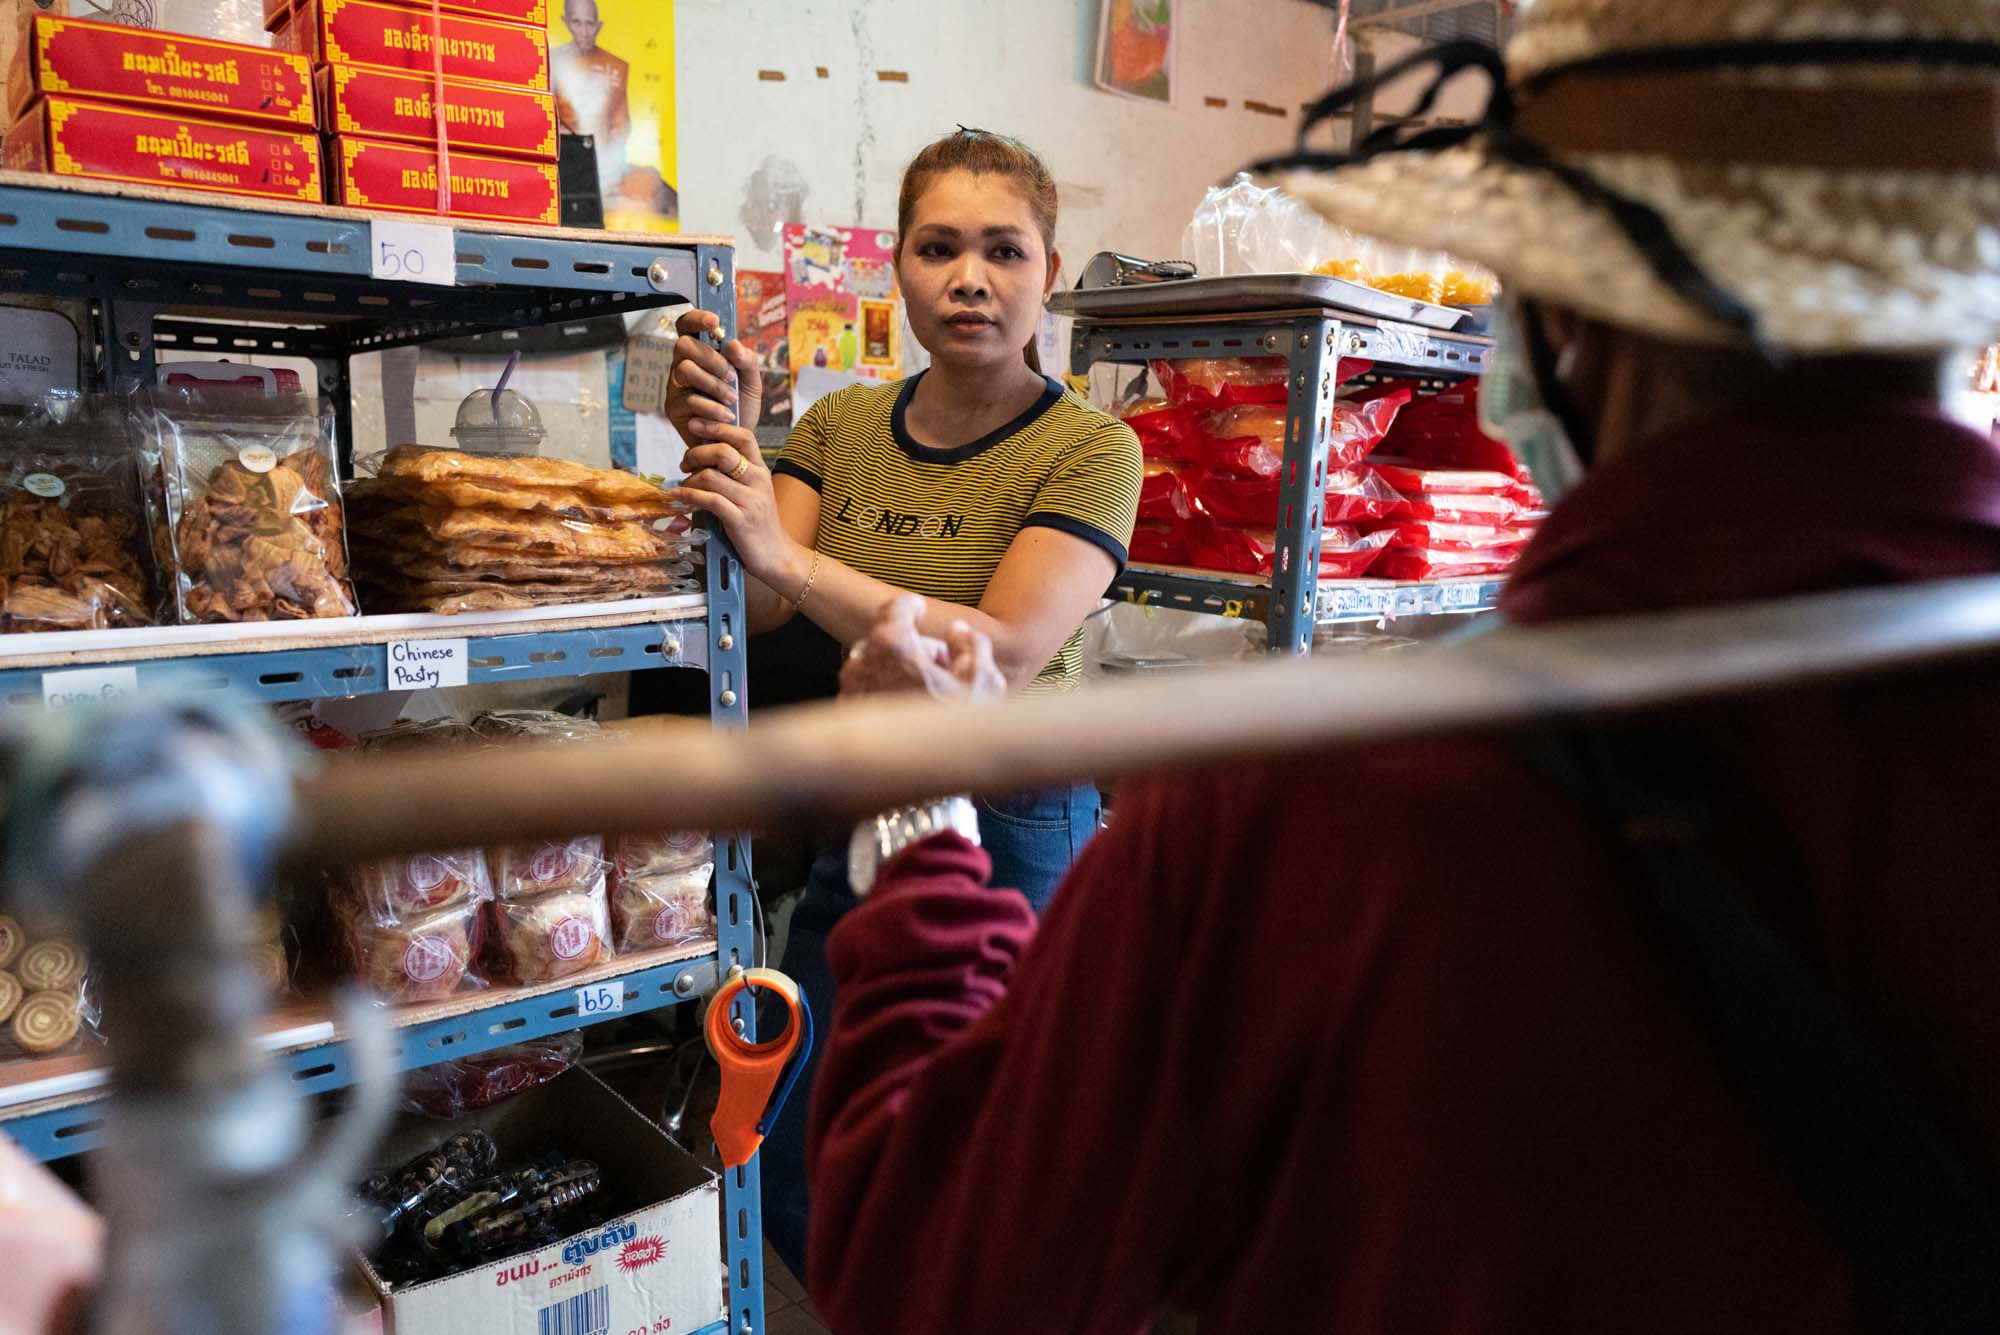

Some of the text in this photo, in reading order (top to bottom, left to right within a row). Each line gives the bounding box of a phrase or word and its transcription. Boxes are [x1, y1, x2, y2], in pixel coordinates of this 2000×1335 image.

[380, 239, 425, 277] 50
[8, 352, 51, 366] TALAD
[836, 497, 965, 538] LONDON
[392, 642, 454, 662] Chinese
[394, 665, 440, 689] Pastry
